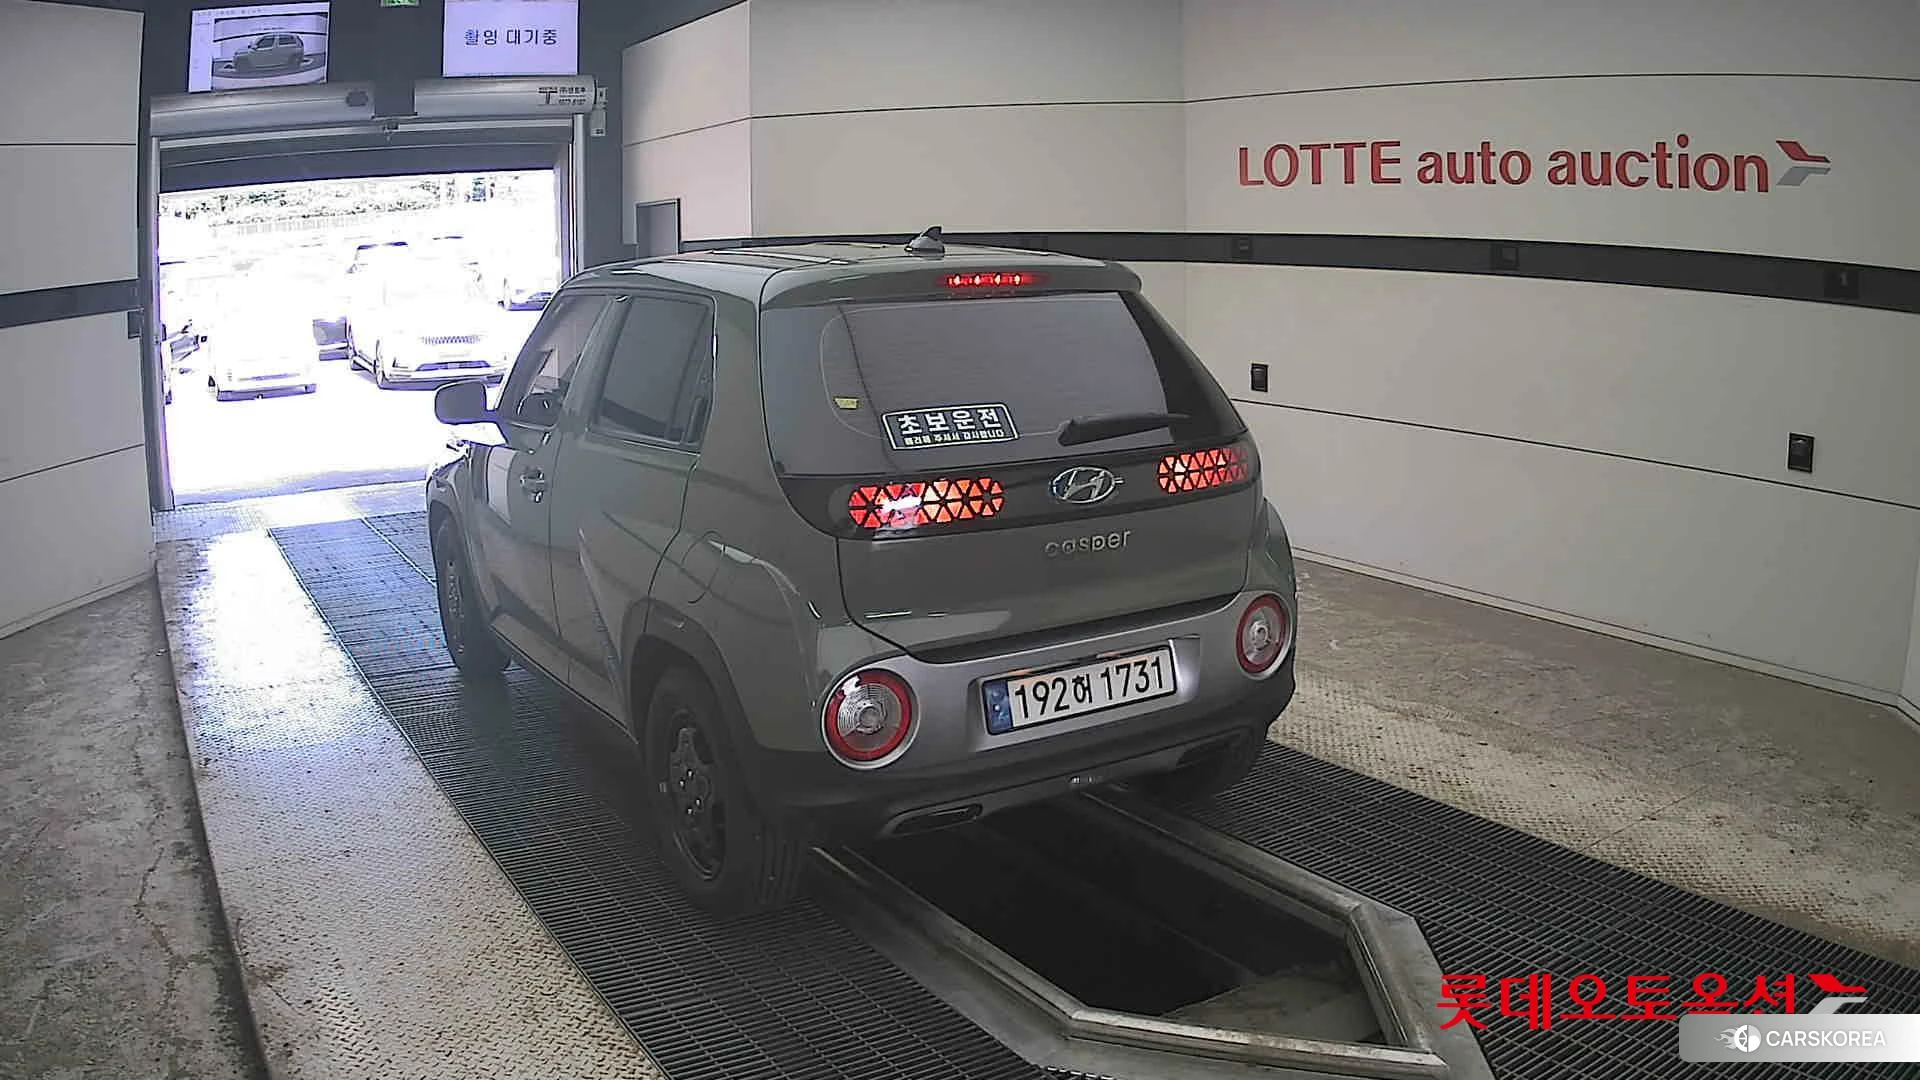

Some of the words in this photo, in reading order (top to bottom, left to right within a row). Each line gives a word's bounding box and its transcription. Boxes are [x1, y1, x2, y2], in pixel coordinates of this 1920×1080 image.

[506, 29, 557, 46] 대기중
[1239, 141, 1401, 187] LOTTE
[1417, 141, 1532, 185] auto
[1547, 133, 1769, 193] auction
[898, 408, 1002, 435] 초보운전
[1045, 530, 1131, 557] casper
[1014, 673, 1093, 718] 192허
[1100, 656, 1163, 700] 1731
